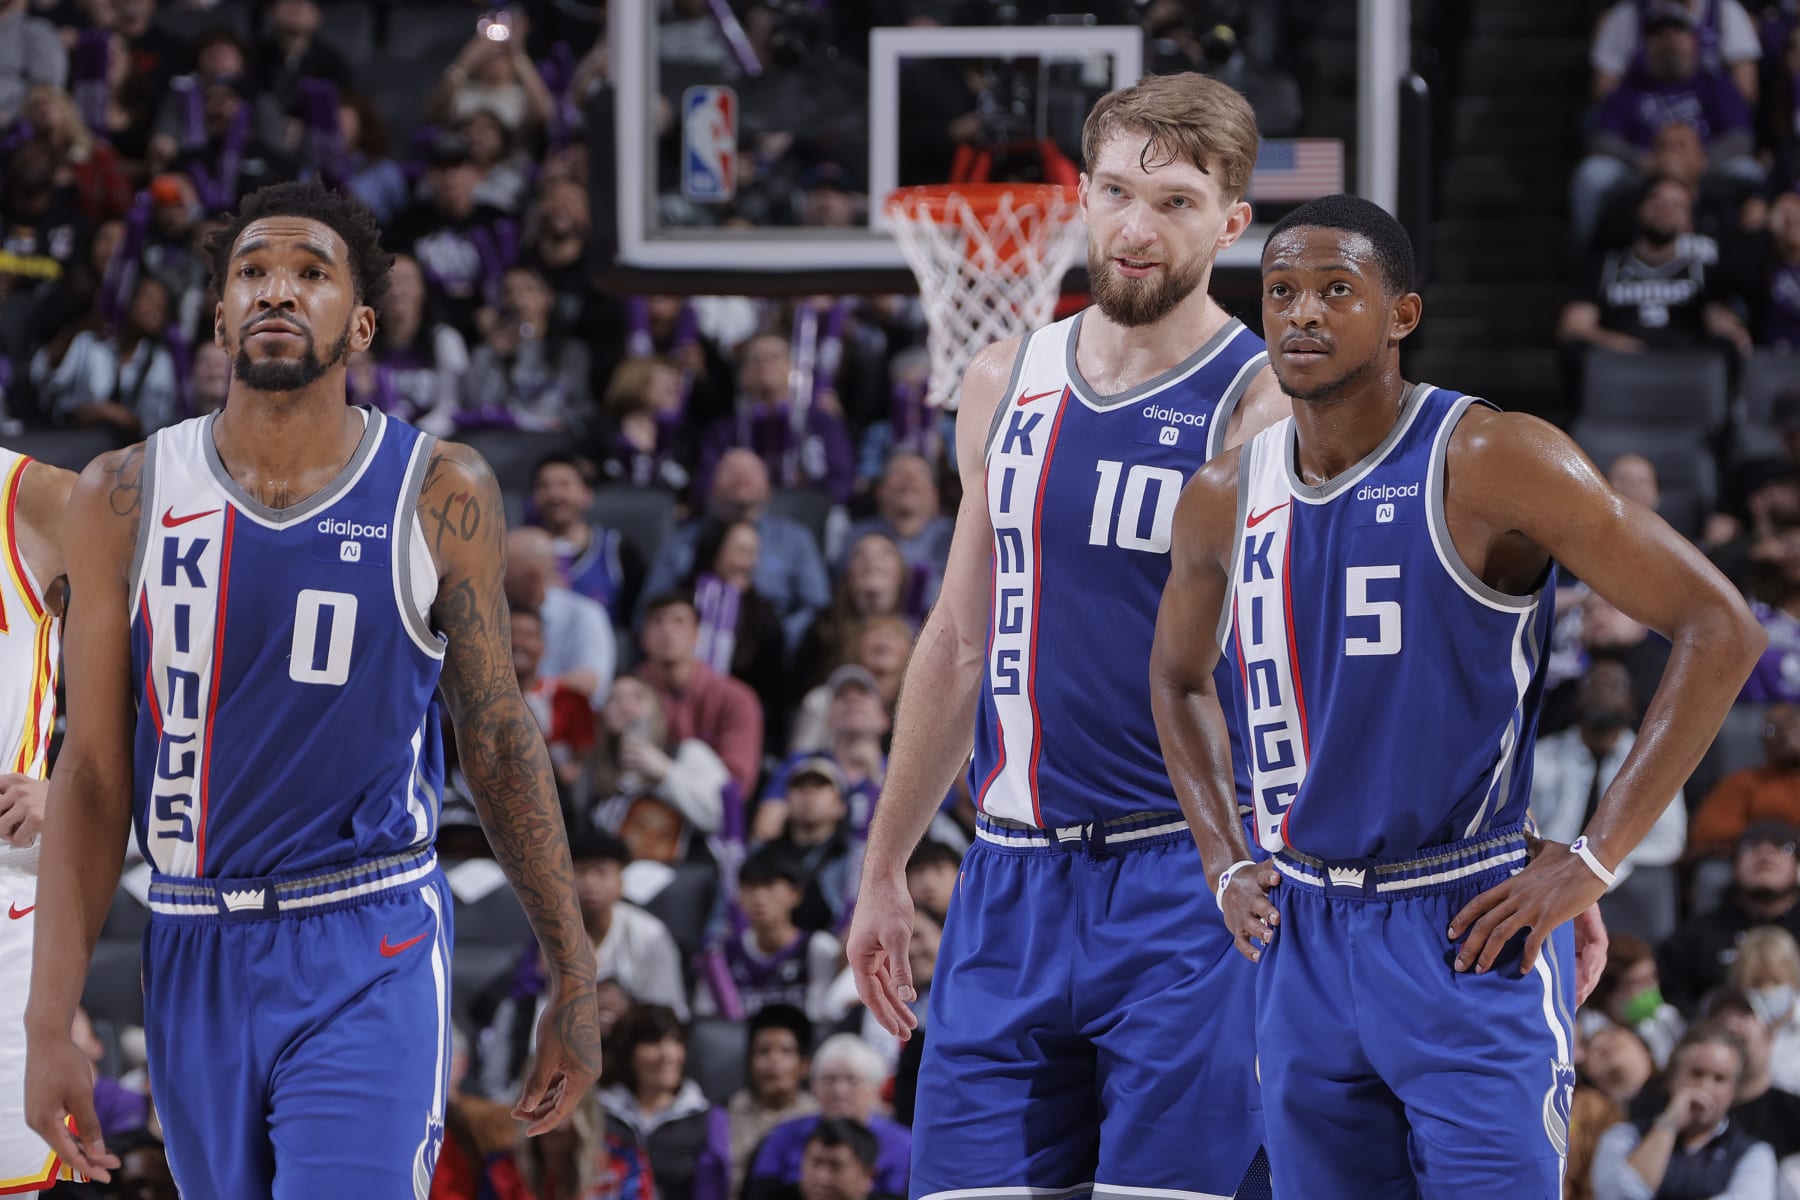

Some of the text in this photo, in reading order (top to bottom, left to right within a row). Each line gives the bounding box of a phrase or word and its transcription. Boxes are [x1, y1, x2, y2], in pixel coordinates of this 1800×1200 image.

[1142, 404, 1207, 427] dialpad
[317, 517, 388, 540] dialpad
[1088, 459, 1184, 554] 10
[1356, 481, 1419, 502] dialpad
[993, 410, 1045, 695] KINGS
[289, 588, 358, 686] 0
[1345, 565, 1402, 656] 5
[155, 536, 211, 843] KINGS
